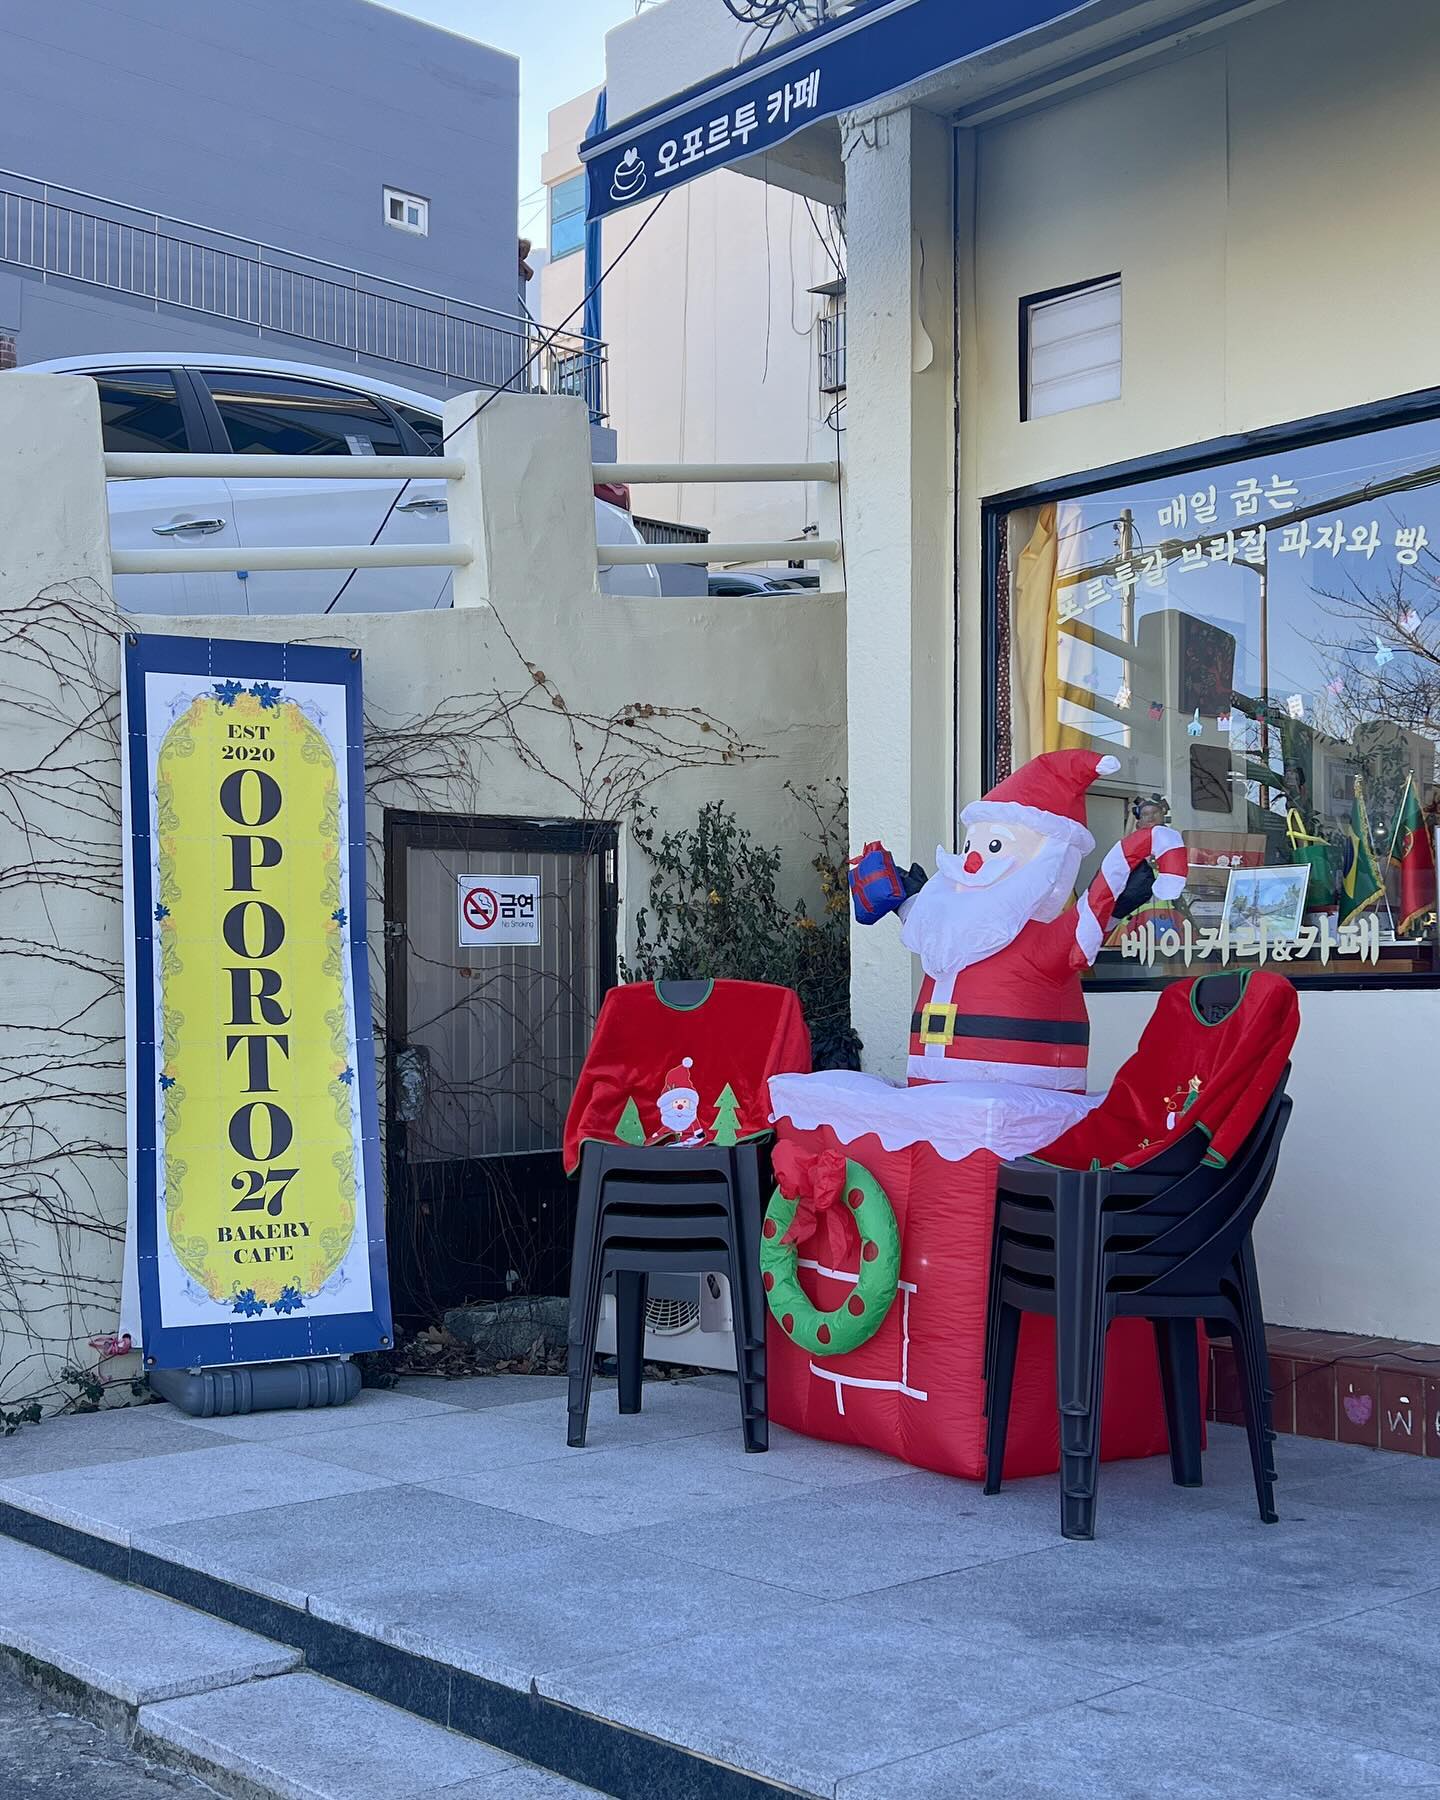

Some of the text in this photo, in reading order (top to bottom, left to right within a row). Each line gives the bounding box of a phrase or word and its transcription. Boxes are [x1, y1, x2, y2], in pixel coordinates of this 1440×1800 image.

[654, 68, 821, 177] 오포르투 카페
[1157, 474, 1299, 529] 매일 굽는
[1056, 519, 1429, 625] 포르투갈 브라질 과자와 빵
[227, 724, 272, 741] EST
[222, 745, 276, 762] 2020
[500, 893, 534, 919] 금연
[511, 920, 534, 929] Smoking
[1121, 912, 1380, 968] 베이커리&카페
[219, 768, 293, 1162] OPORTO
[231, 1167, 300, 1217] 27
[217, 1221, 313, 1242] BAKERY
[233, 1245, 294, 1264] CAFE
